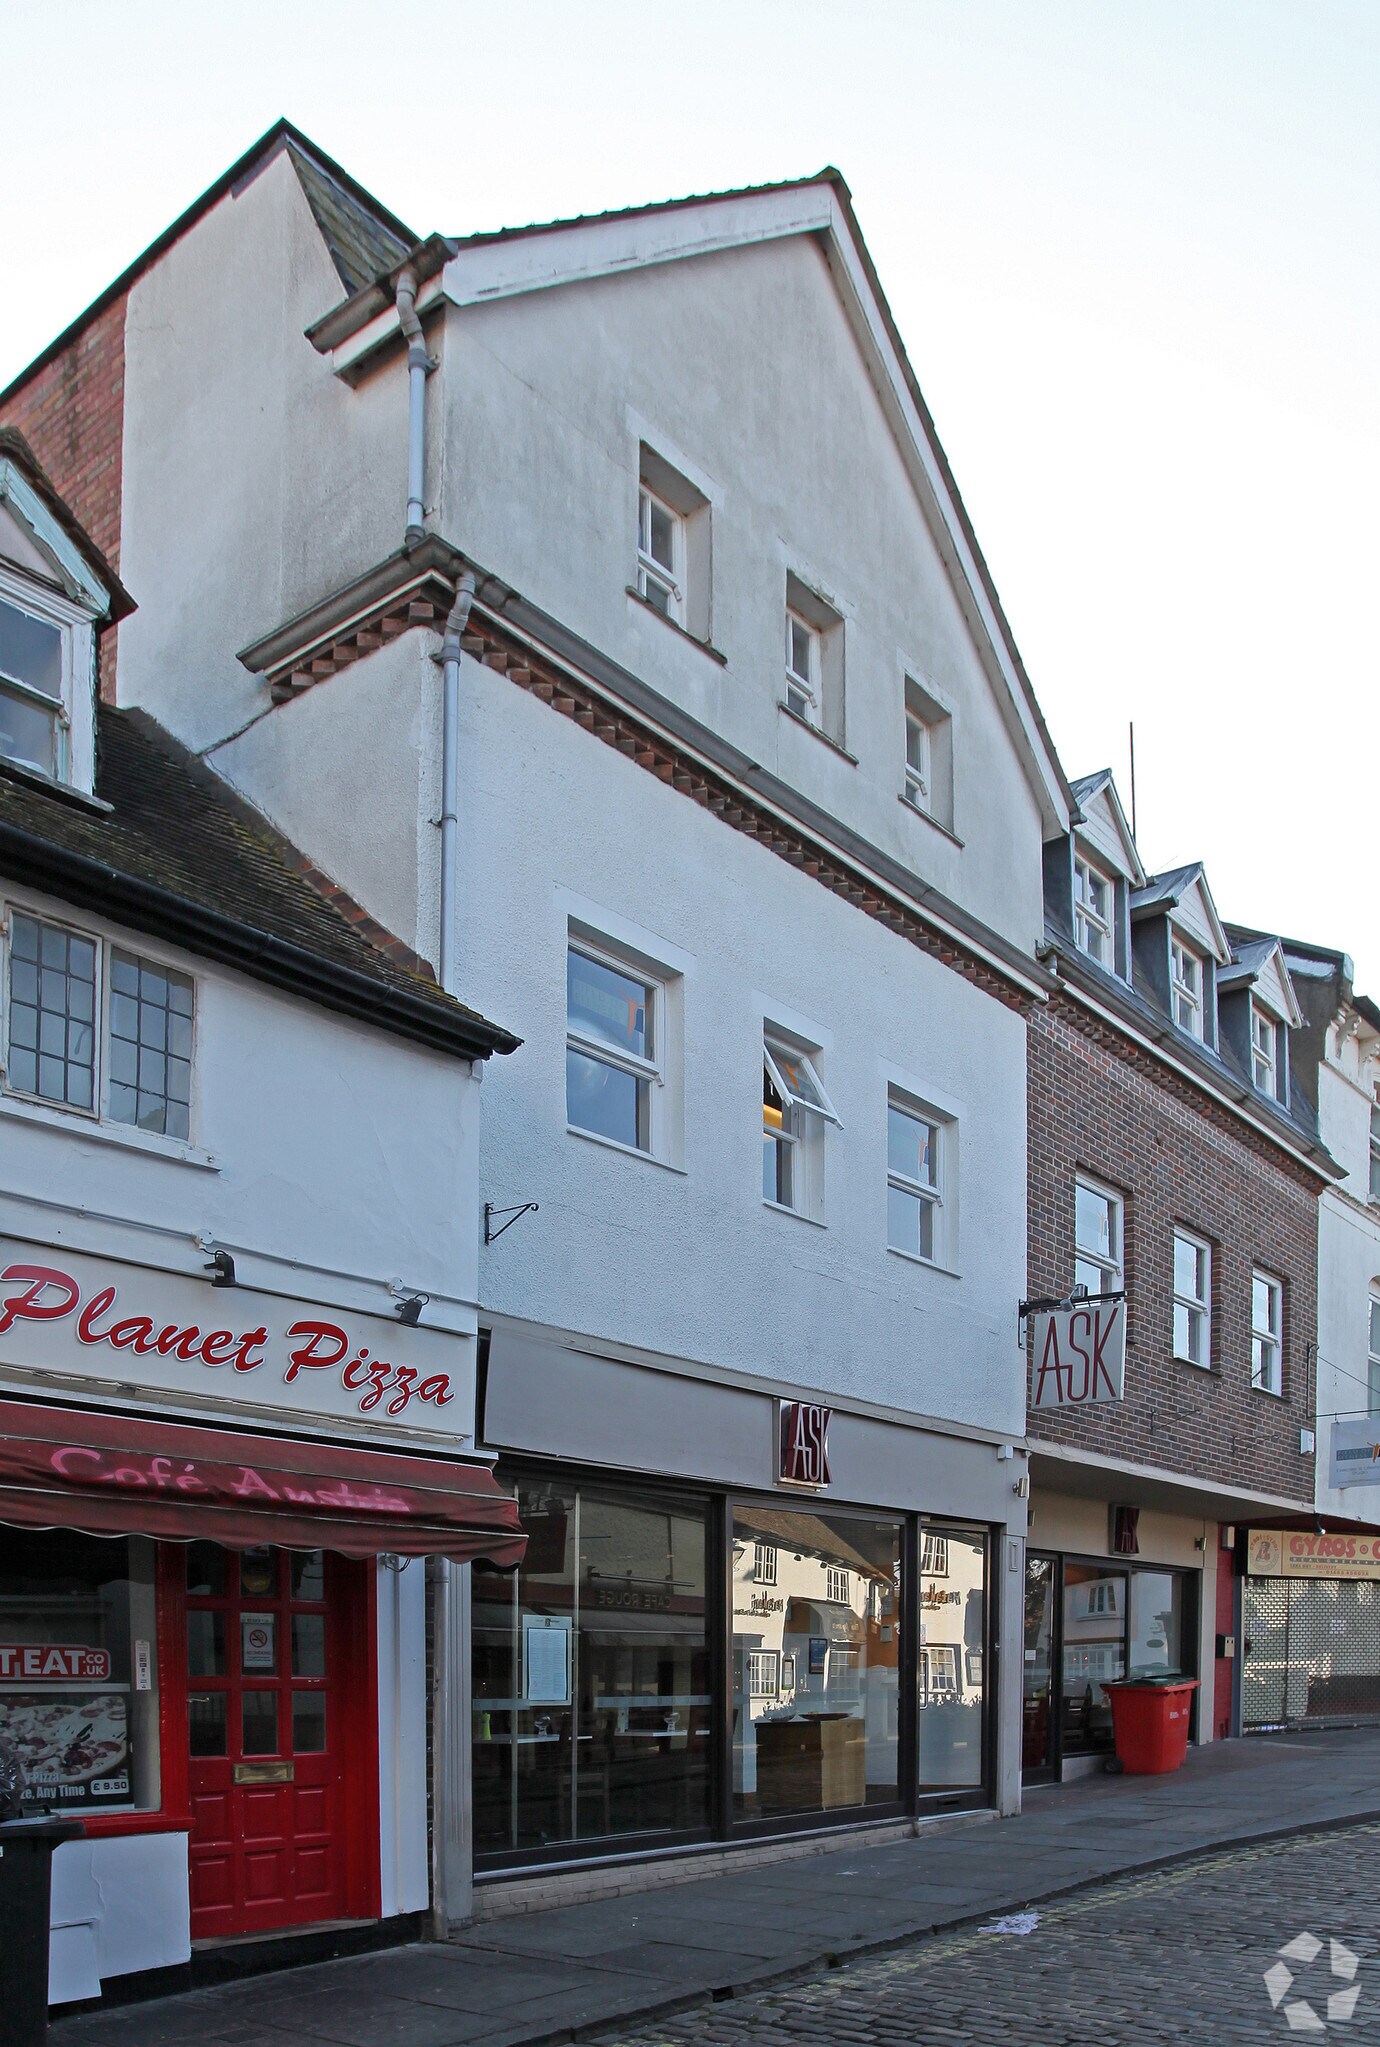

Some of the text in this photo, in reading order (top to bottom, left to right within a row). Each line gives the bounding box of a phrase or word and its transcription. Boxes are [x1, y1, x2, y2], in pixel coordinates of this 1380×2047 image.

[0, 1264, 456, 1417] Planet Pizza
[1035, 1307, 1119, 1405] ASK
[791, 1403, 834, 1484] ASK
[51, 1448, 207, 1494] Café
[1289, 1535, 1356, 1558] GYROS
[24, 1649, 85, 1674] EAT
[33, 1772, 60, 1784] Pizza
[103, 1780, 128, 1790] 9.50
[36, 1786, 57, 1799] Any
[58, 1784, 85, 1797] Time
